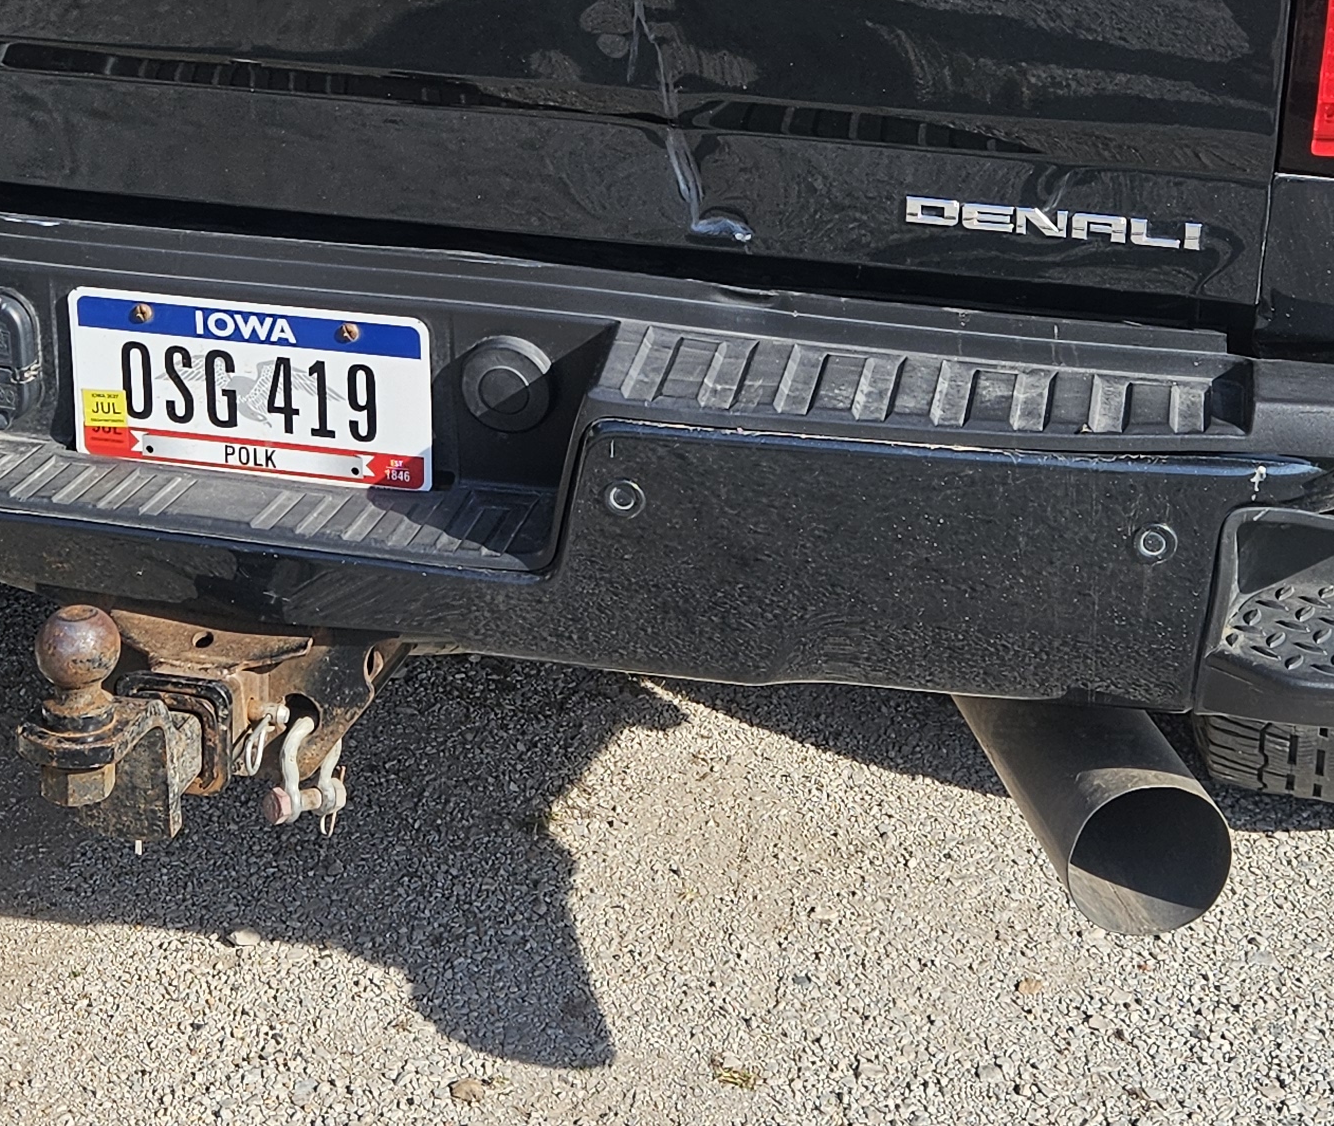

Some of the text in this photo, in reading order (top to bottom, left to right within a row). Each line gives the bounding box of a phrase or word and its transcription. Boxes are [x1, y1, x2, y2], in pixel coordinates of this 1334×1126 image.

[905, 195, 1203, 251] DENALI
[195, 310, 297, 344] IOWA
[121, 341, 377, 442] OSG 419
[91, 401, 122, 415] JUL
[224, 444, 277, 469] POLK
[384, 468, 411, 483] 1846
